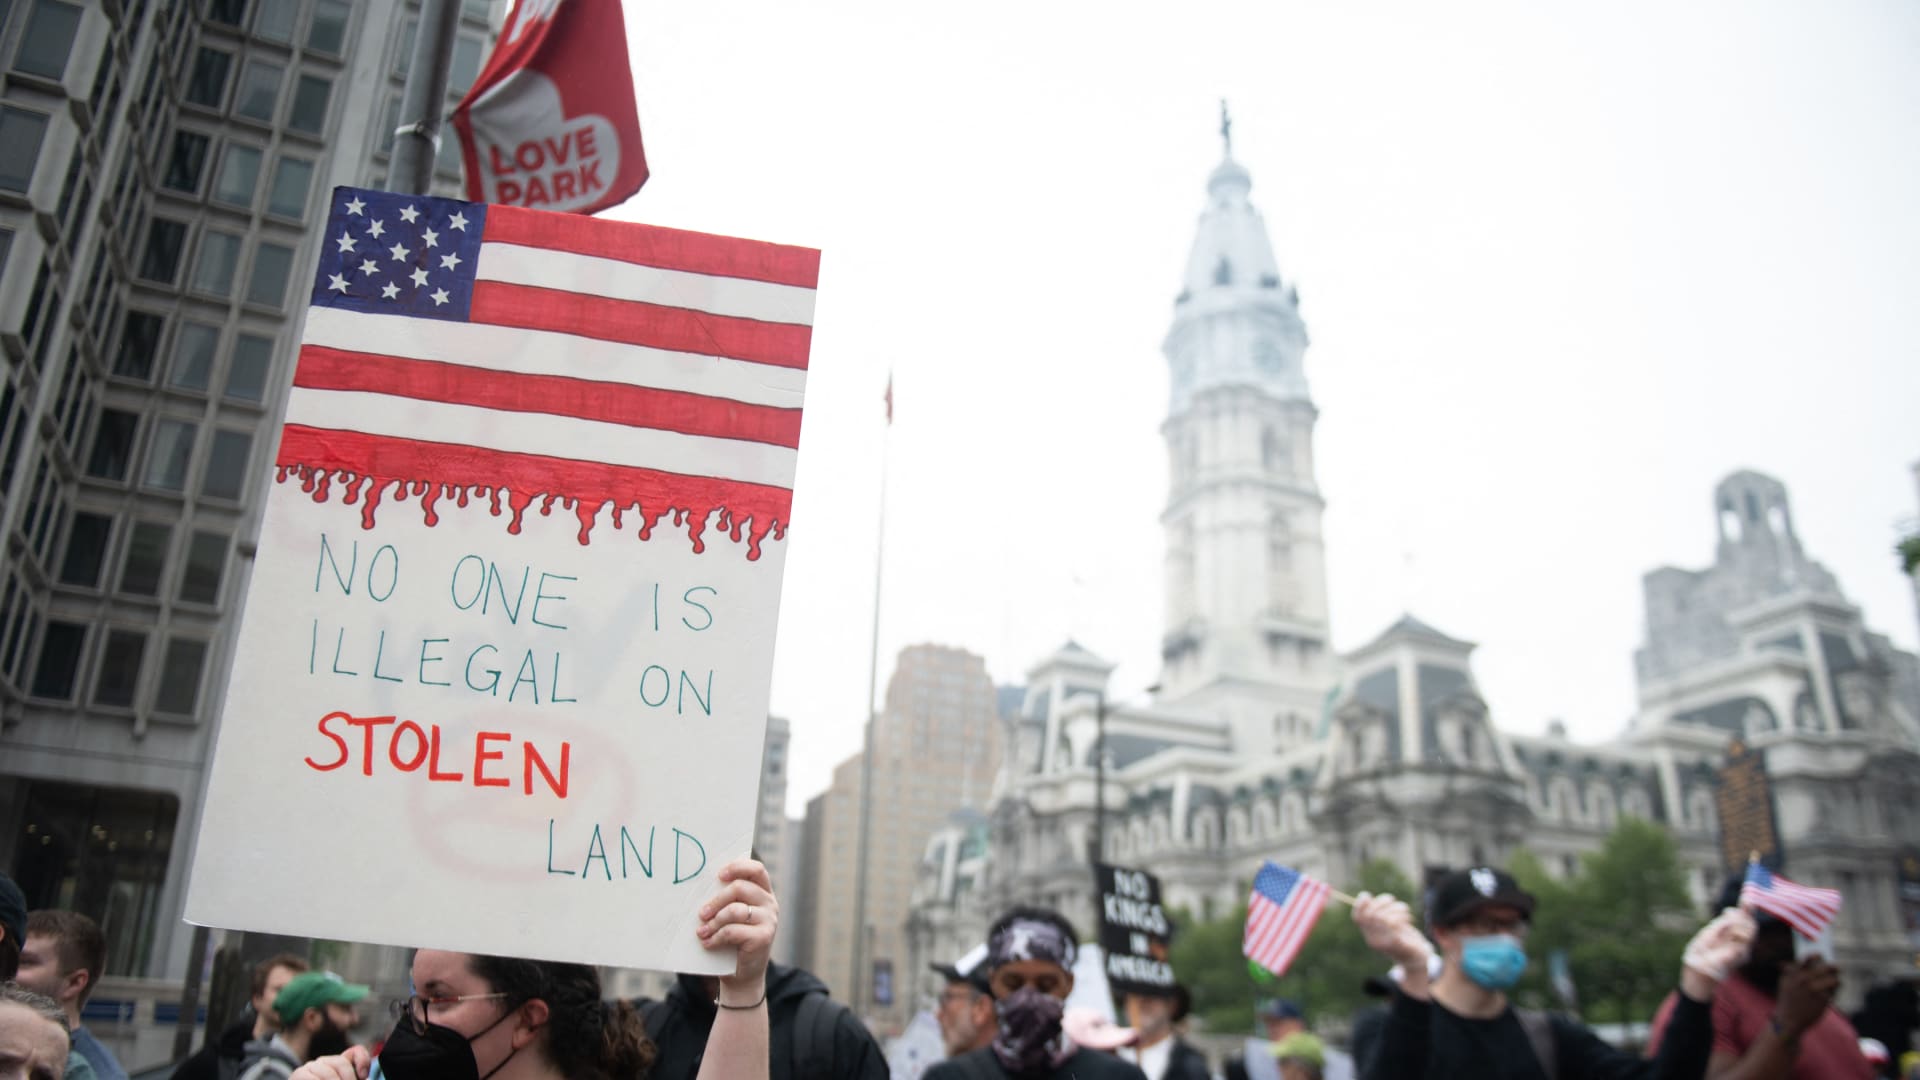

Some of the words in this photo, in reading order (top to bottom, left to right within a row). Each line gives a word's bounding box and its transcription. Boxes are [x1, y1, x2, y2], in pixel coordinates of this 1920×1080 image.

[490, 124, 597, 177] LOVE
[496, 159, 603, 207] PARK
[315, 533, 399, 602] NO
[451, 554, 578, 630] ONE
[654, 583, 717, 632] IS
[310, 618, 578, 705] ILLEGAL
[639, 664, 715, 716] ON
[304, 711, 571, 799] STOLEN
[548, 818, 707, 885] LAND
[1104, 894, 1167, 934] KINGS
[1115, 870, 1148, 899] NO
